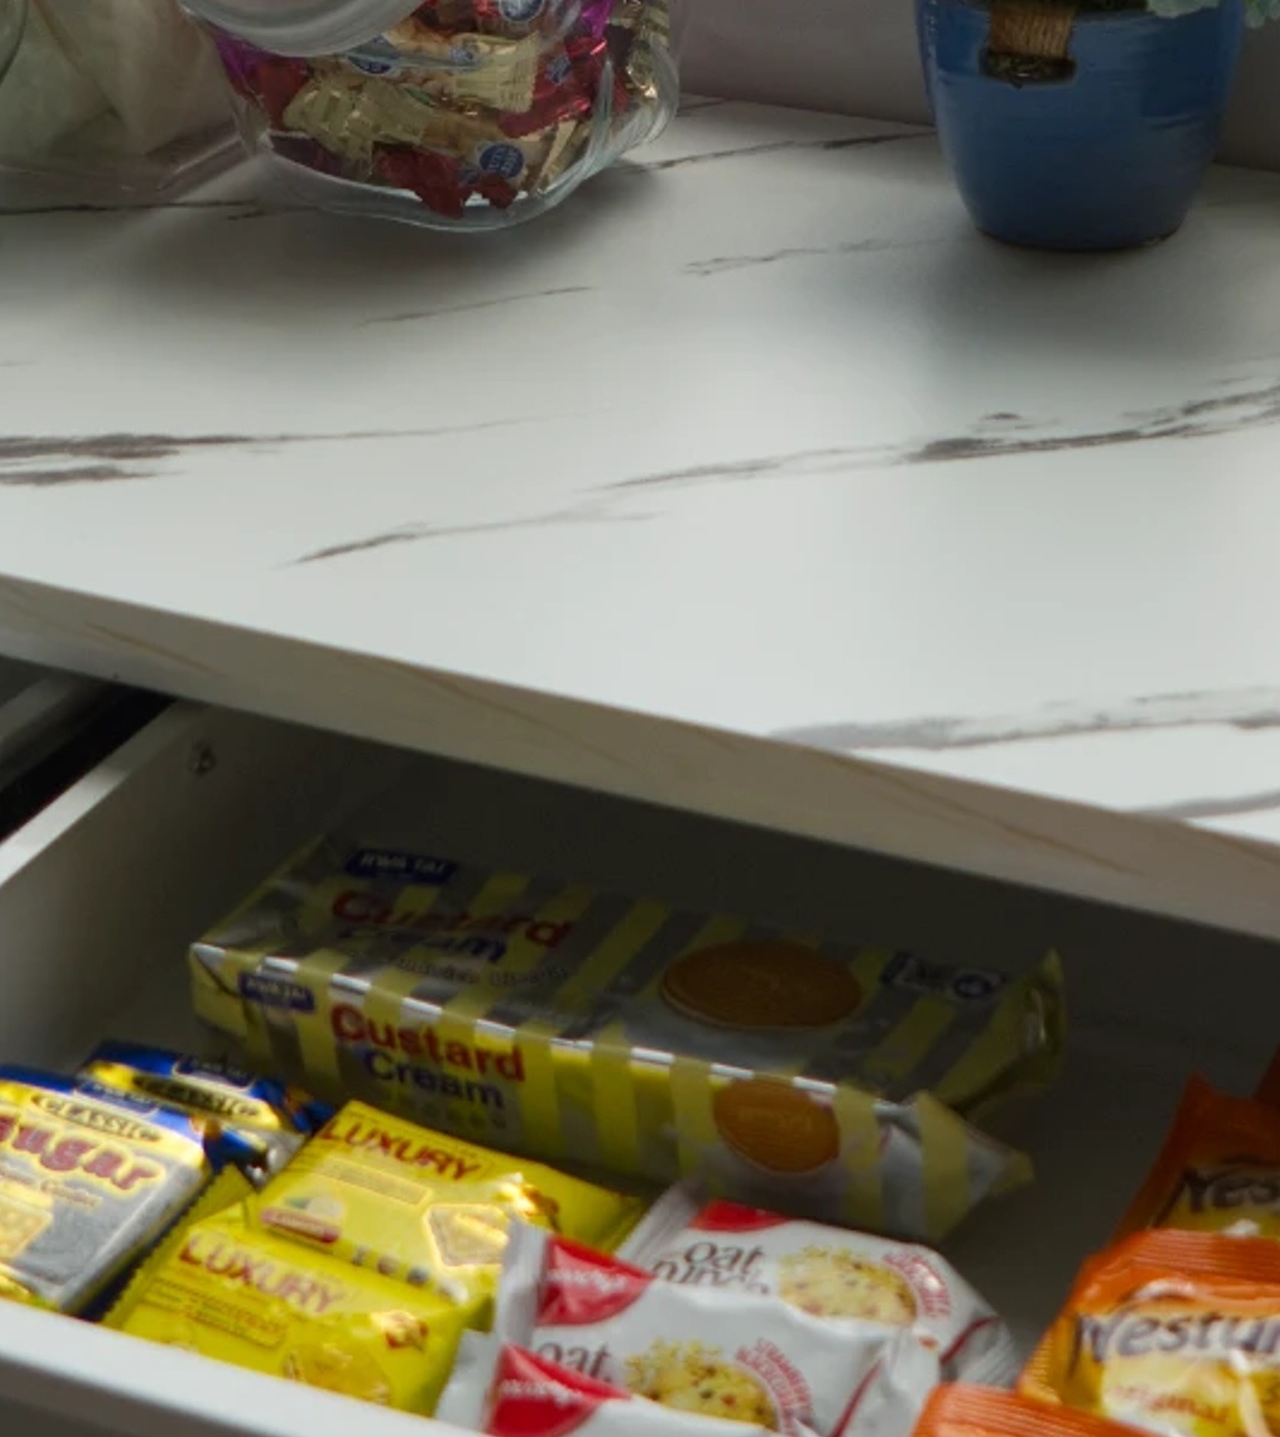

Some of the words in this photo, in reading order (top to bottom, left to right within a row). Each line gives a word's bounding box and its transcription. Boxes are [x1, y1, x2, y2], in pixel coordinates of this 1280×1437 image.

[332, 890, 574, 947] Custard
[331, 1005, 525, 1081] Custard
[366, 1051, 505, 1109] Cream
[322, 1119, 482, 1181] LUXURY
[178, 1234, 345, 1313] LUXURY
[683, 1241, 765, 1275] oat
